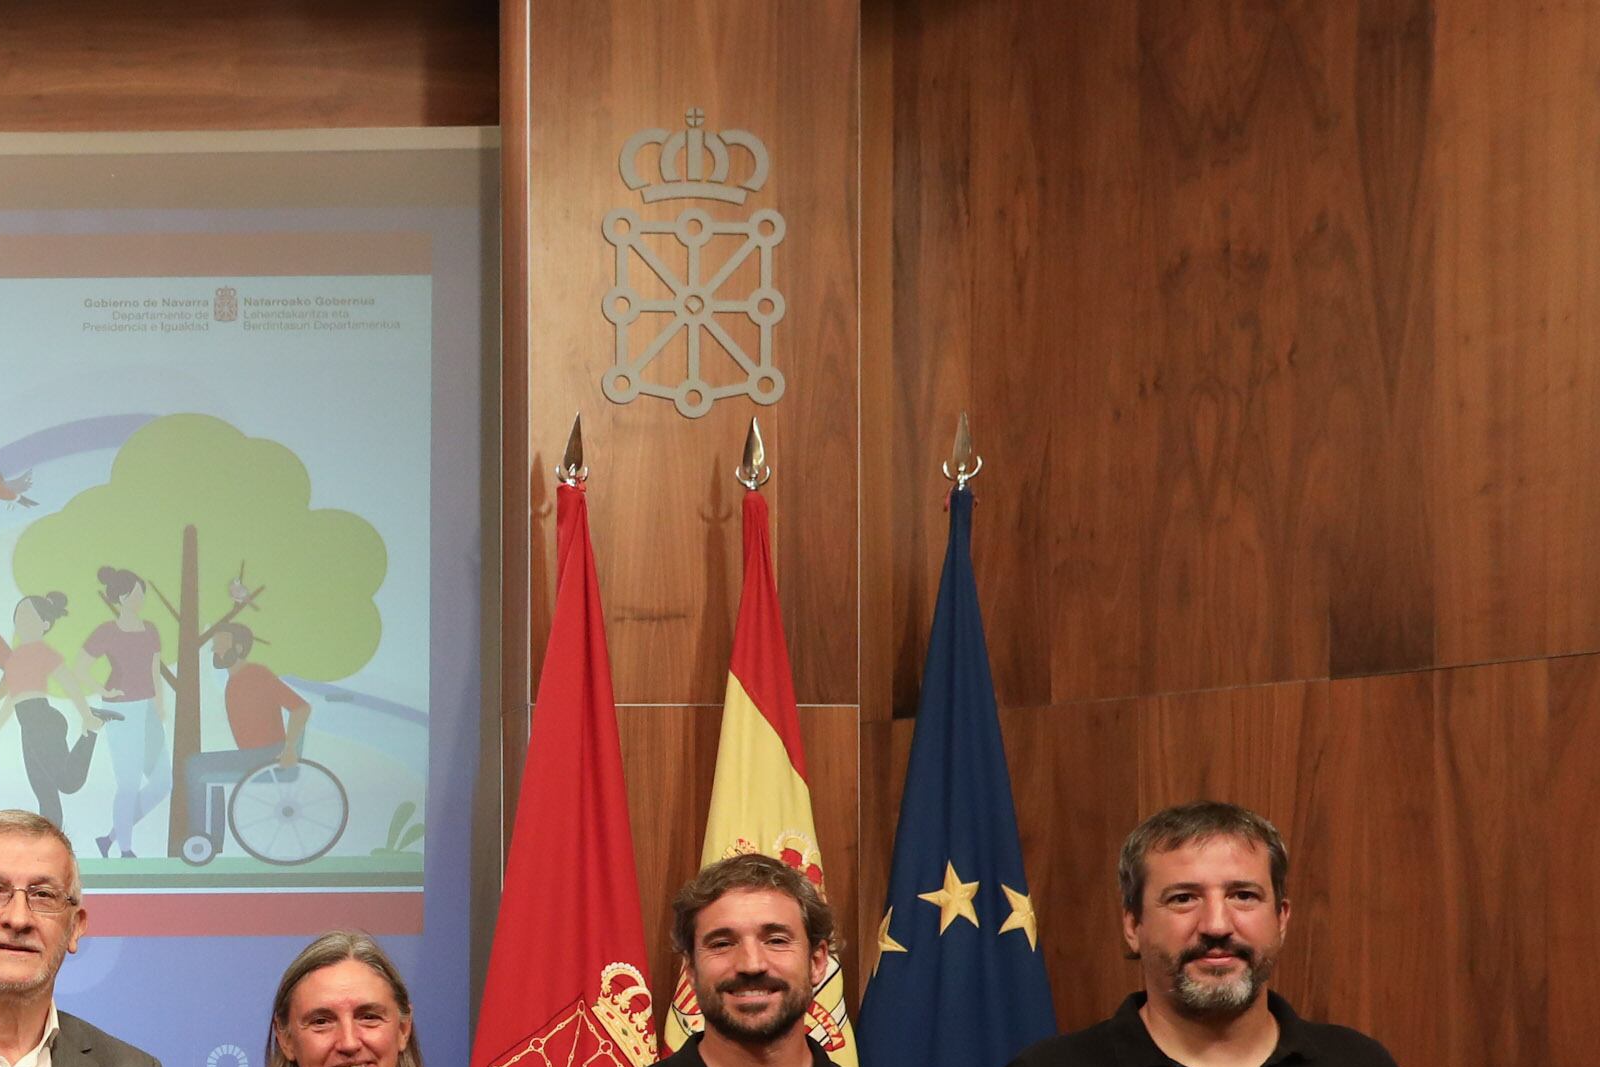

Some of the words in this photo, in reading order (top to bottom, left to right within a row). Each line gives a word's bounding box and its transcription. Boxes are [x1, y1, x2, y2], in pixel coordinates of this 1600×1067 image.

[84, 298, 140, 308] Gobierno
[143, 298, 158, 307] de
[162, 298, 209, 307] Navarra
[243, 296, 311, 306] Nafarroako
[315, 295, 375, 306] Gobernua
[112, 310, 192, 321] Departamento
[195, 310, 209, 320] de
[82, 322, 147, 332] Presidencia
[161, 321, 209, 333] Igualdad
